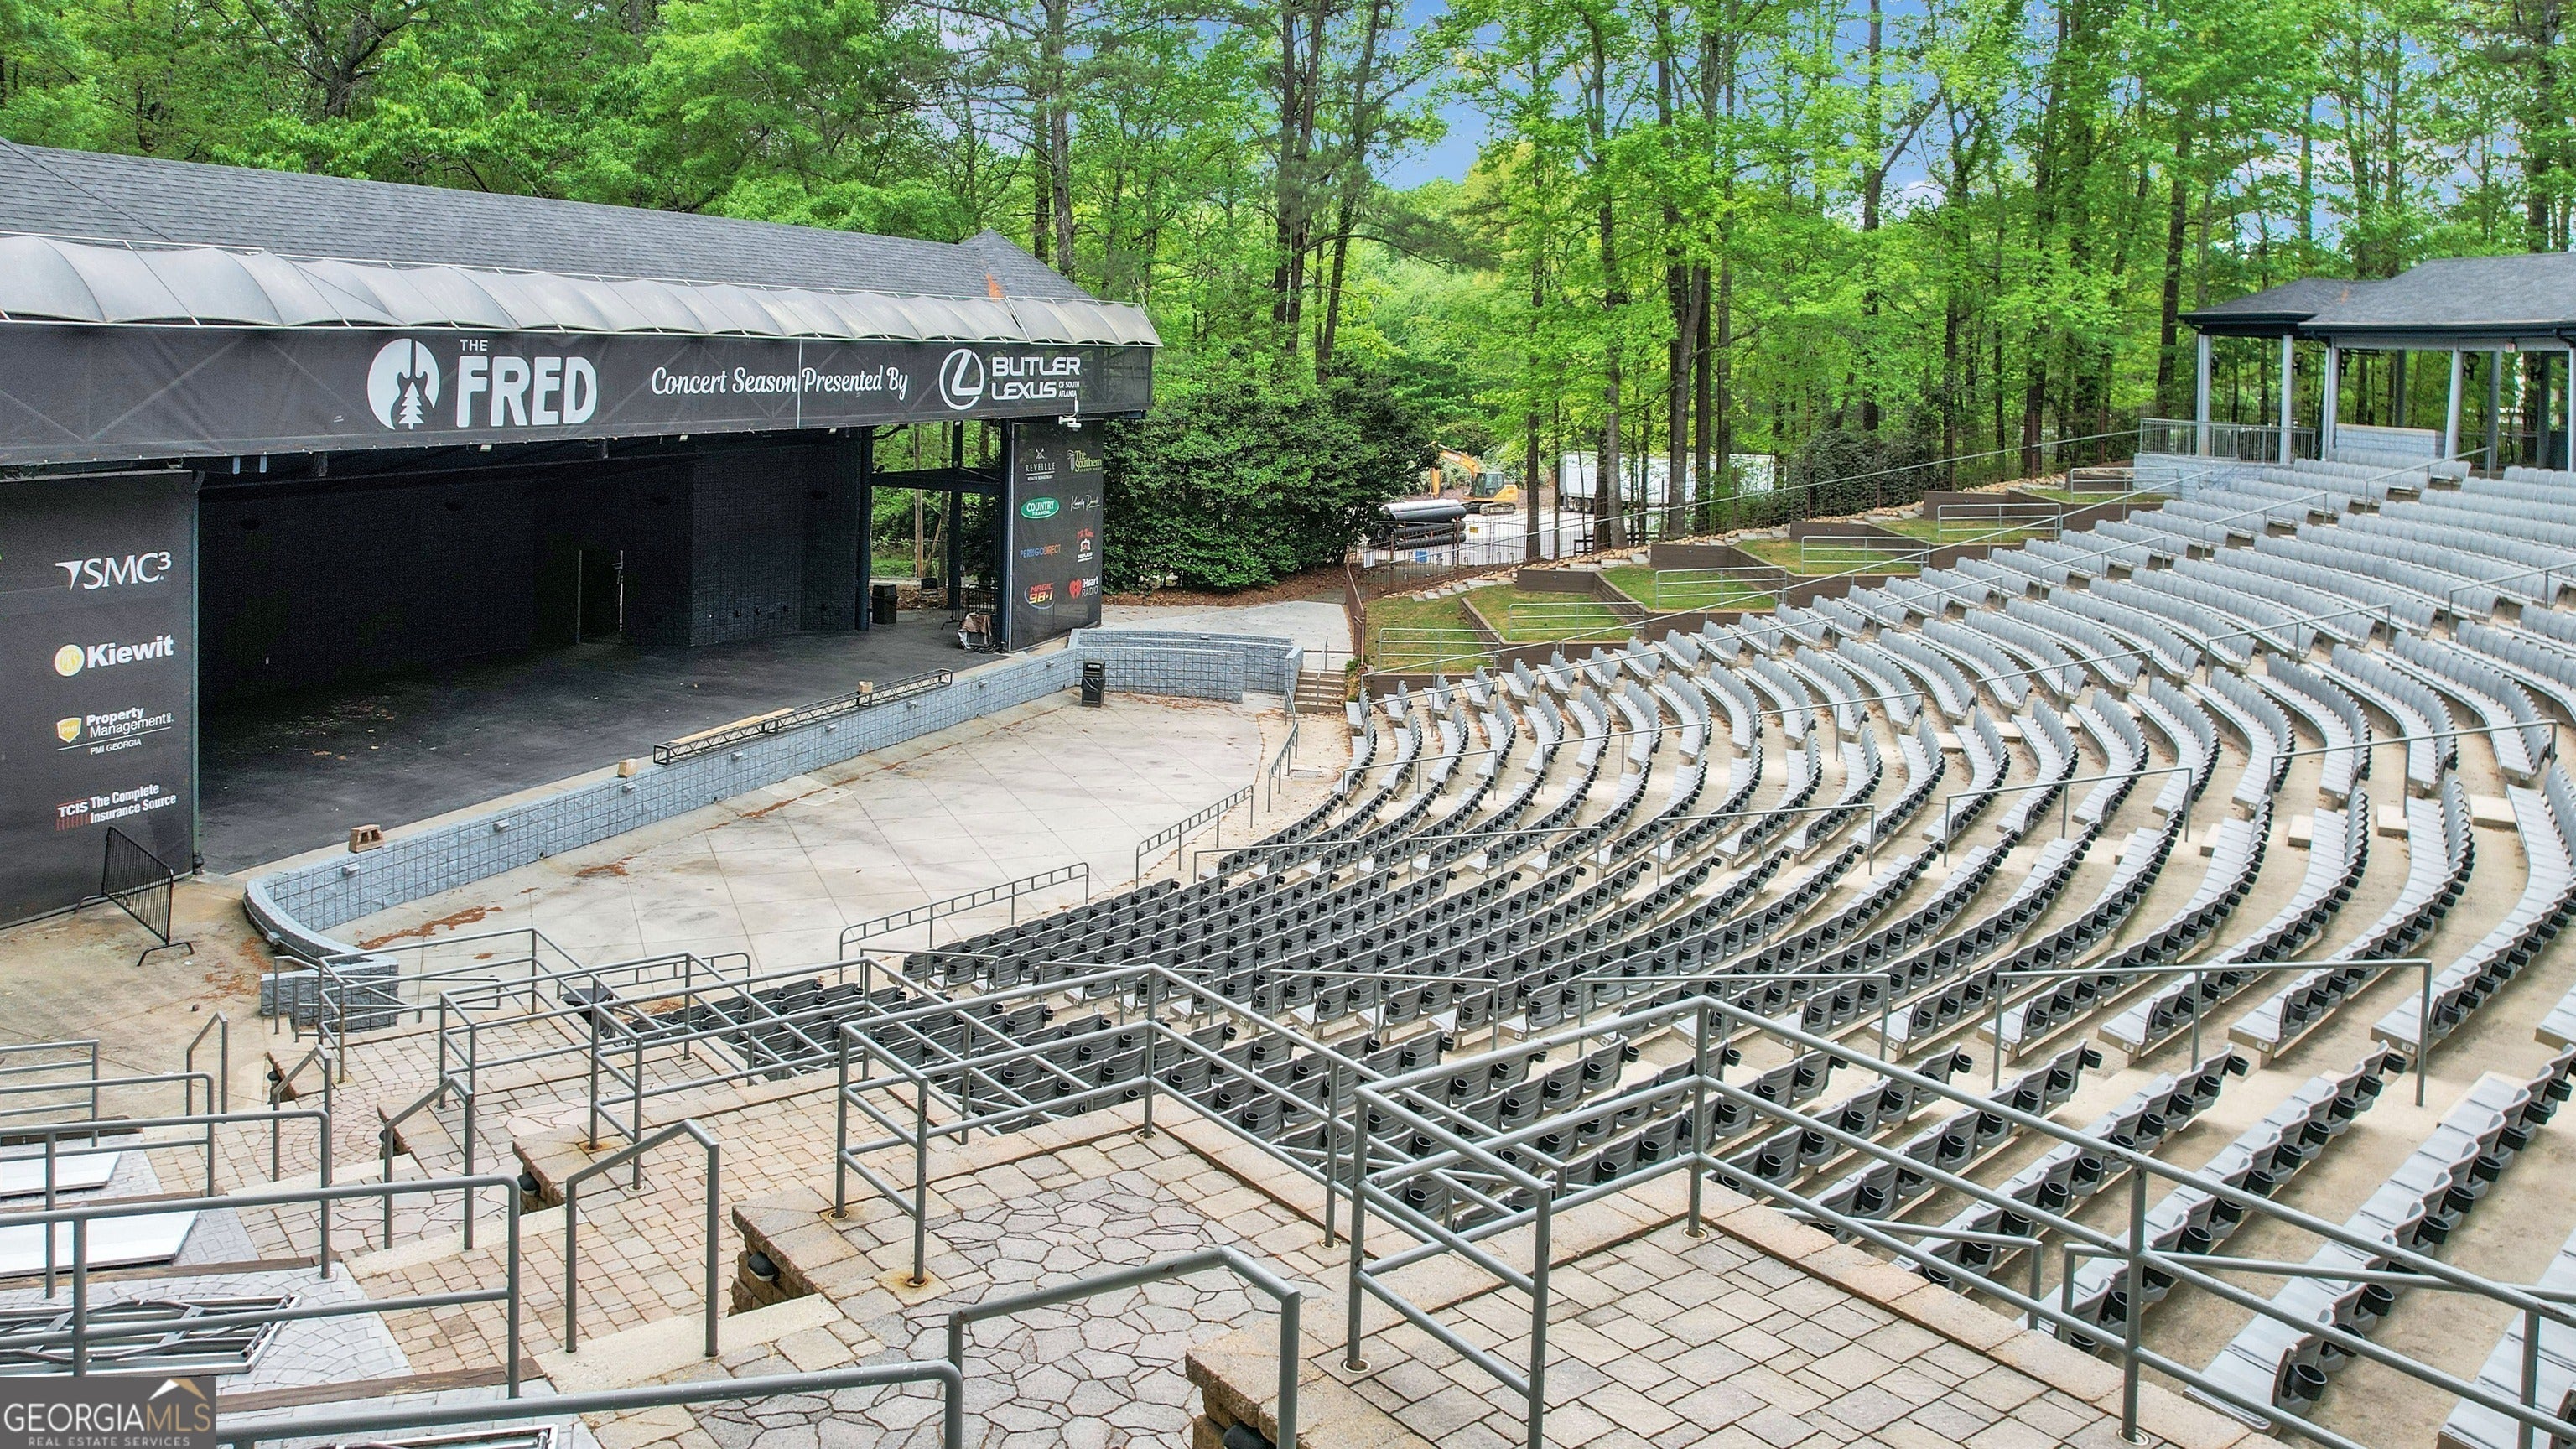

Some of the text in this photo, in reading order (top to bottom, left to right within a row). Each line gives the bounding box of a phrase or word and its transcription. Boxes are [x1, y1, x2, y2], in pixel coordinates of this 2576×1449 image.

[460, 339, 488, 351] THE
[992, 356, 1081, 377] BUTLER
[651, 365, 908, 400] Concert Season Presented By
[991, 382, 1057, 400] LEXUS
[456, 356, 597, 428] FRED
[1075, 450, 1087, 460] The
[1025, 462, 1055, 472] REVEILLE
[1075, 458, 1102, 472] Southern
[1026, 501, 1055, 512] COUNTRY
[1030, 583, 1054, 593] MAGIC
[1082, 576, 1098, 588] iHeart
[1082, 586, 1098, 597] RADIO
[87, 635, 174, 668] Kiewit
[86, 707, 144, 726] Property
[90, 714, 166, 738] Management
[90, 739, 142, 755] PMI GEORGIA
[91, 784, 160, 808] The Complete
[57, 801, 88, 818] TCIS
[90, 795, 177, 824] Insurance Source
